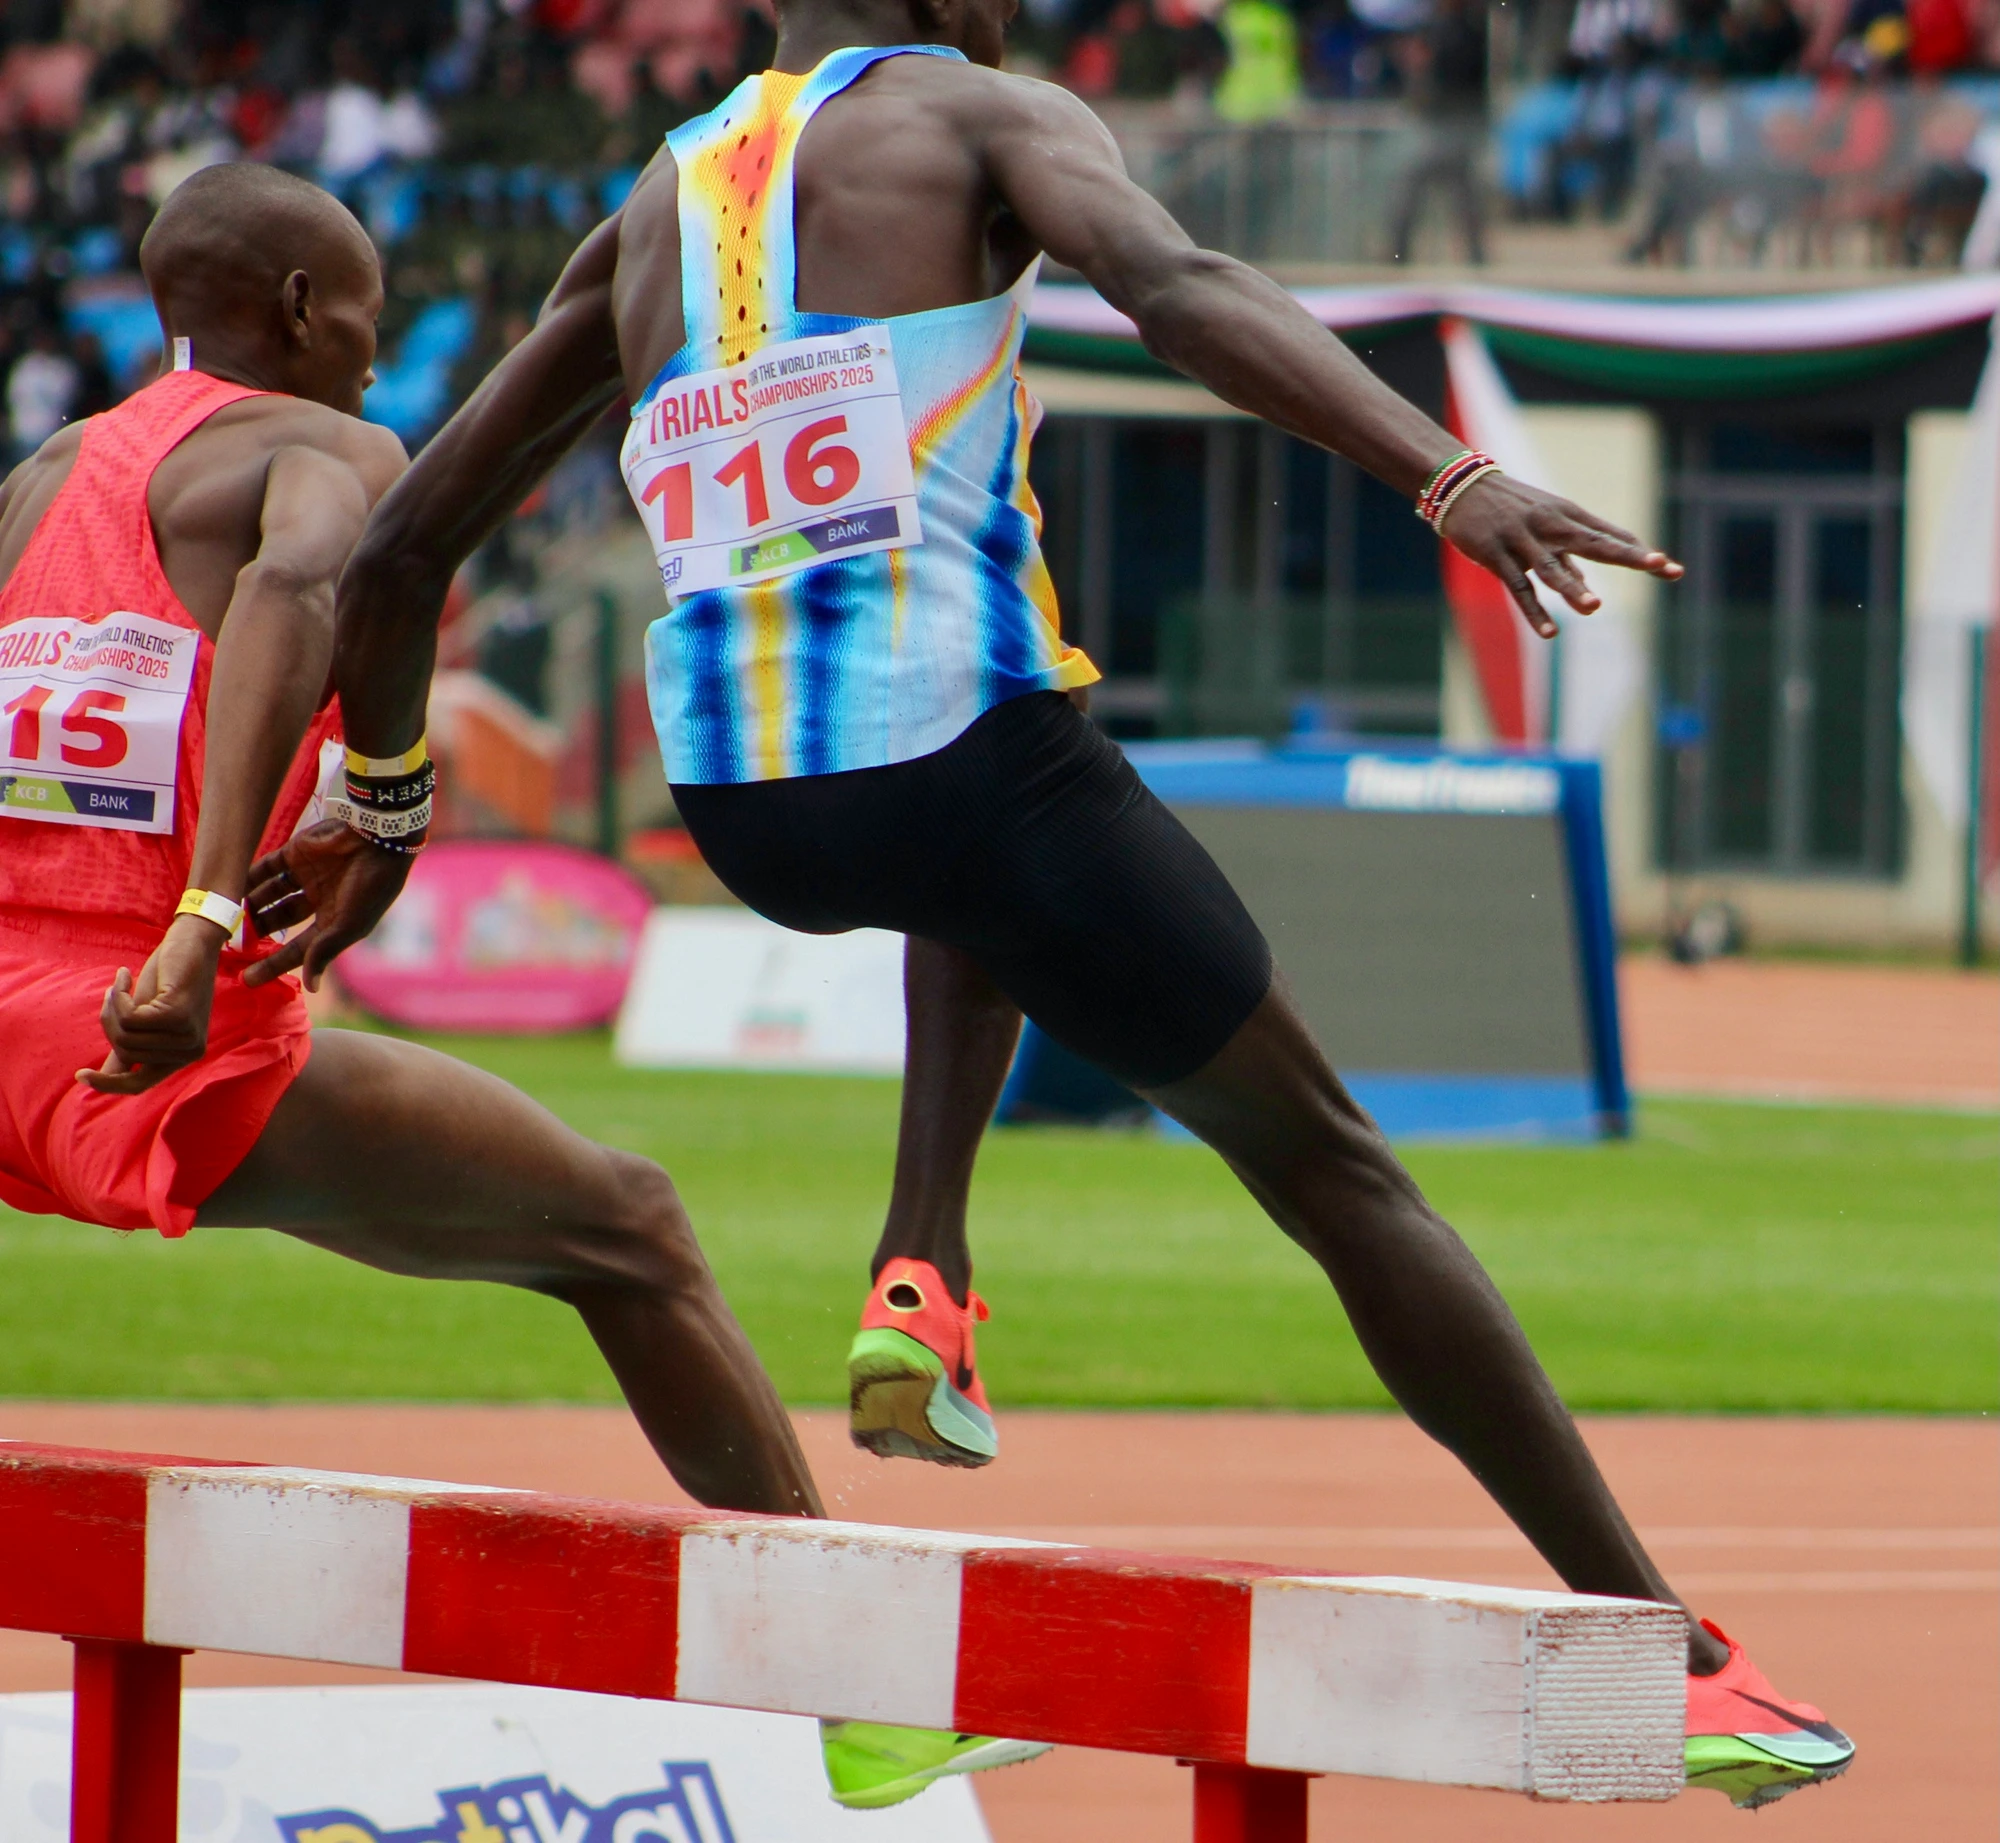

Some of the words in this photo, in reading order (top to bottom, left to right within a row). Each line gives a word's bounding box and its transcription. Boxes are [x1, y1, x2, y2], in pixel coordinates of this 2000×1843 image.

[759, 362, 777, 382] THE
[777, 353, 815, 375] WORLD
[817, 342, 871, 367] ATHLETICS
[750, 371, 838, 413] CHAMPIONSHIPS
[840, 364, 874, 388] 2025
[650, 378, 749, 445] TRIALS
[640, 415, 860, 543] 116
[761, 543, 789, 562] KCB
[827, 520, 870, 542] BANK
[63, 647, 136, 672] CHASHIPS
[136, 655, 169, 679] 2025
[122, 628, 174, 656] ATHLETICS
[3, 684, 128, 768] 15
[15, 785, 48, 801] KCB
[89, 793, 129, 810] BANK
